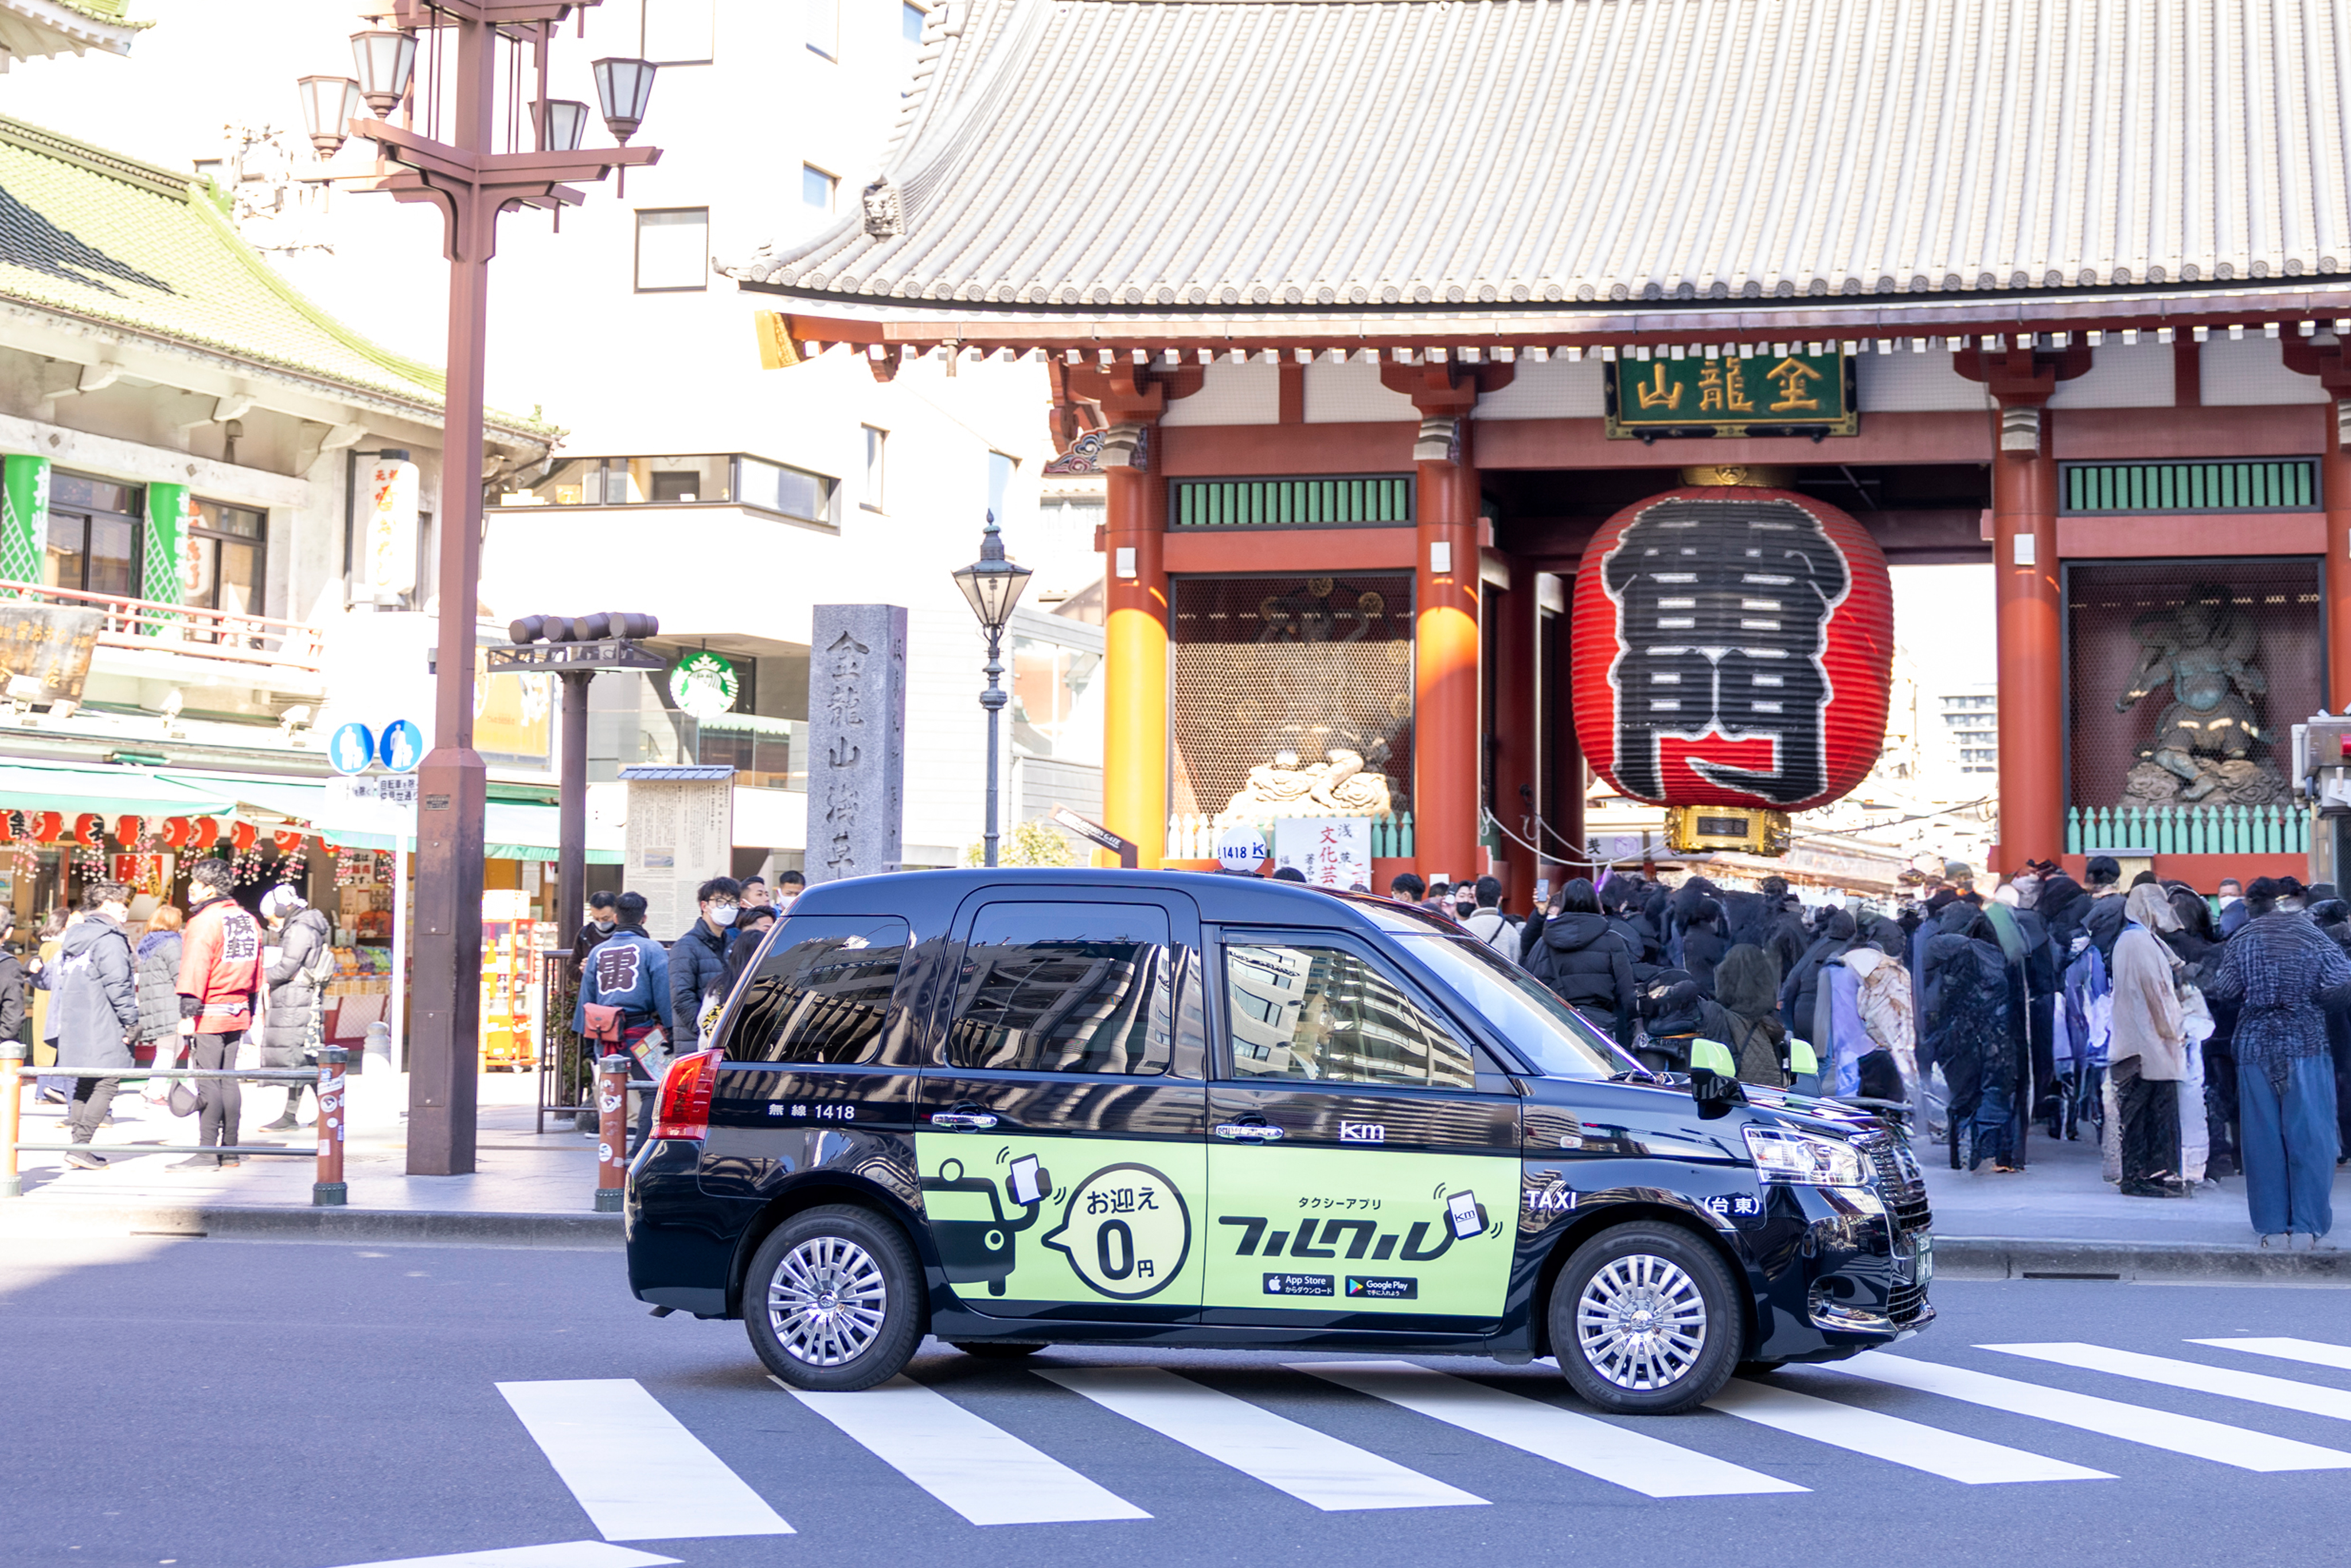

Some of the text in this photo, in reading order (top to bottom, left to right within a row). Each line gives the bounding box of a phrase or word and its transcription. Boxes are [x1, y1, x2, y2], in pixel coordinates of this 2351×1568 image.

[1637, 357, 1823, 412] 金龍山
[1601, 496, 1852, 802] 雷門
[380, 779, 418, 790] 自転車を除
[1223, 846, 1247, 858] 1418
[1319, 826, 1338, 886] 文化芸
[597, 944, 640, 995] 雷
[768, 1104, 854, 1119] 無線 1418
[1087, 1187, 1159, 1215] お迎え
[1298, 1197, 1381, 1210] タクシーアプリ
[1526, 1190, 1576, 1209] TAXI
[1704, 1196, 1760, 1214] (台東)
[1285, 1276, 1326, 1285] App Store
[1366, 1280, 1408, 1291] Google Play
[1285, 1286, 1333, 1294] からダウンロード
